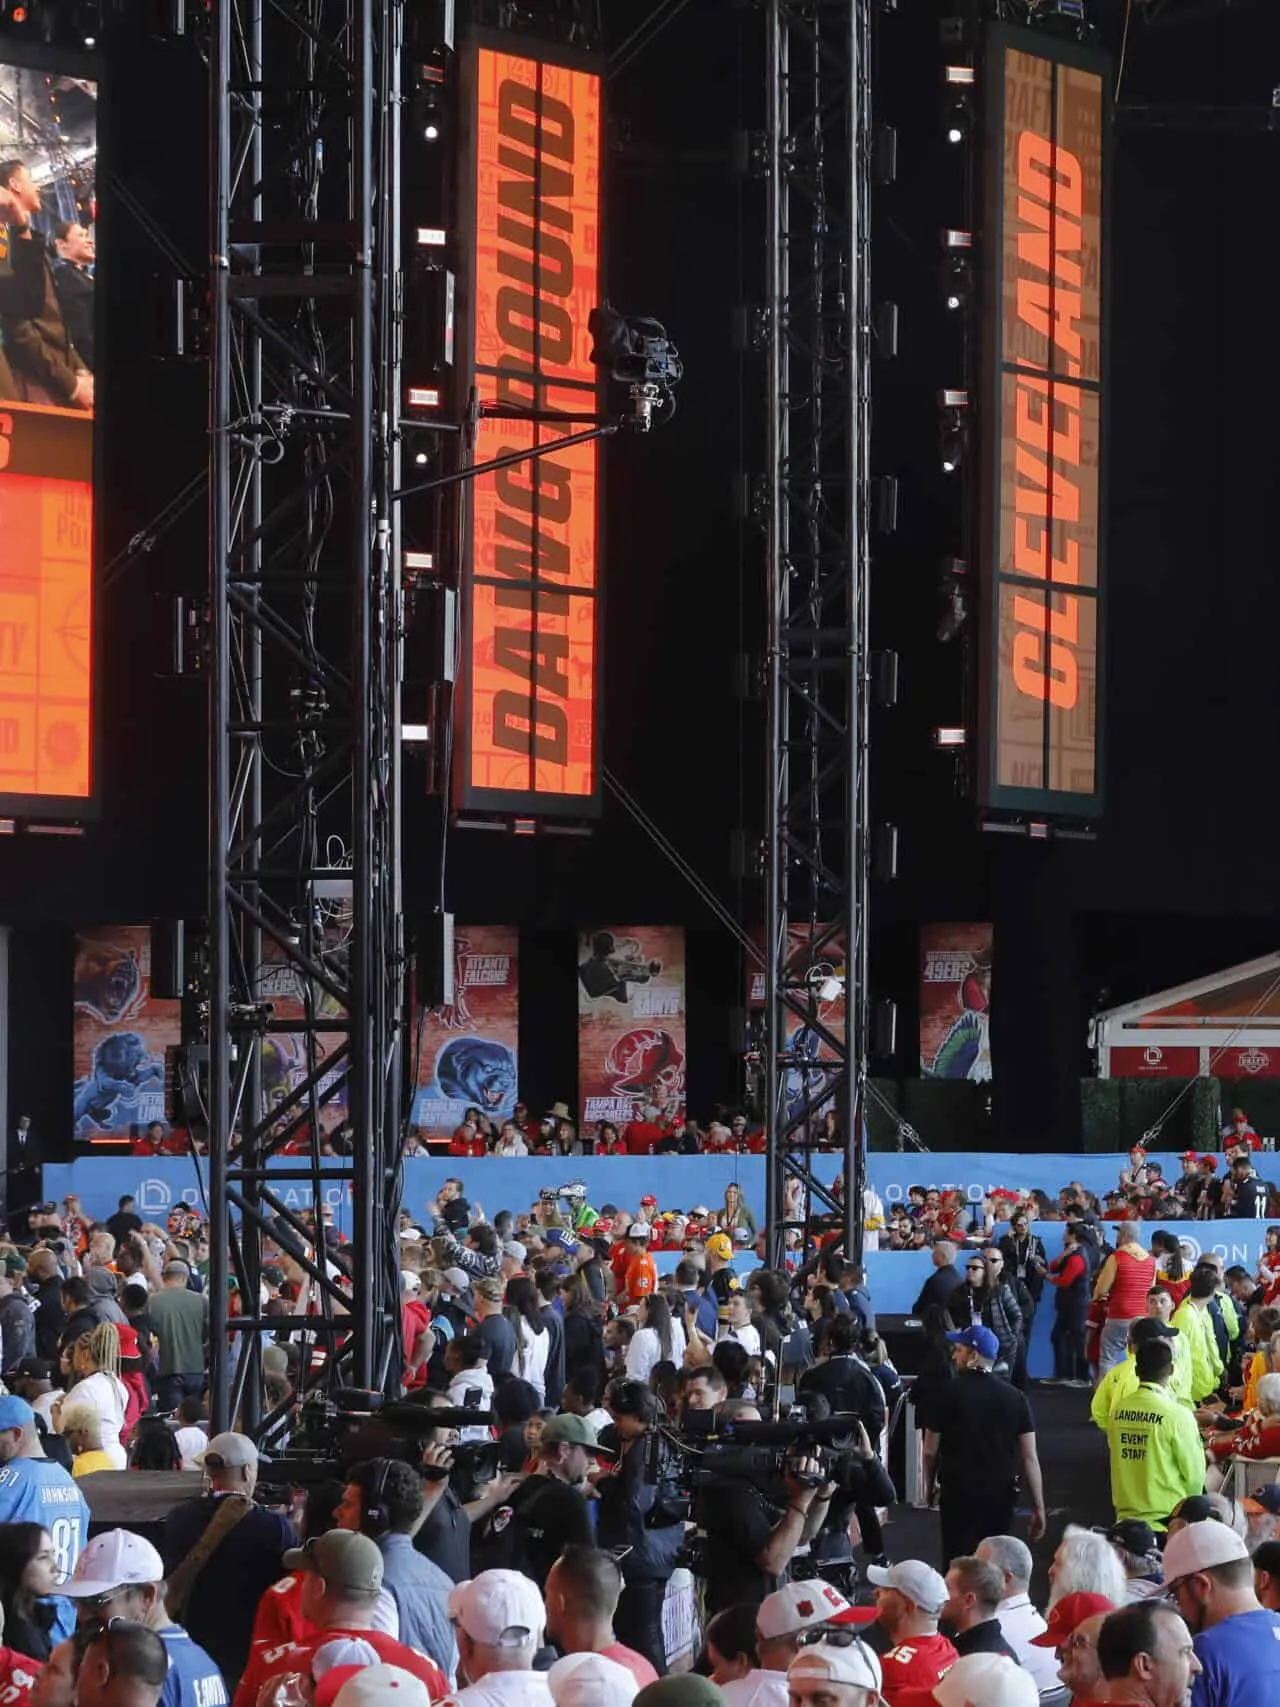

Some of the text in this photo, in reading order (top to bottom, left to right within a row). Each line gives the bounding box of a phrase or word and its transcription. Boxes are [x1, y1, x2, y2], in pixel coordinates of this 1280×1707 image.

[496, 78, 575, 438] POUND
[1013, 130, 1083, 710] CLEVELAND
[492, 446, 573, 767] DAWG
[1254, 1195, 1266, 1219] 11
[1212, 1244, 1247, 1262] ON
[1115, 1410, 1163, 1425] LANDMARK
[1120, 1432, 1149, 1446] EVENT
[1120, 1447, 1147, 1460] STAFF
[42, 1487, 80, 1504] JOHNSON
[52, 1518, 80, 1585] 81
